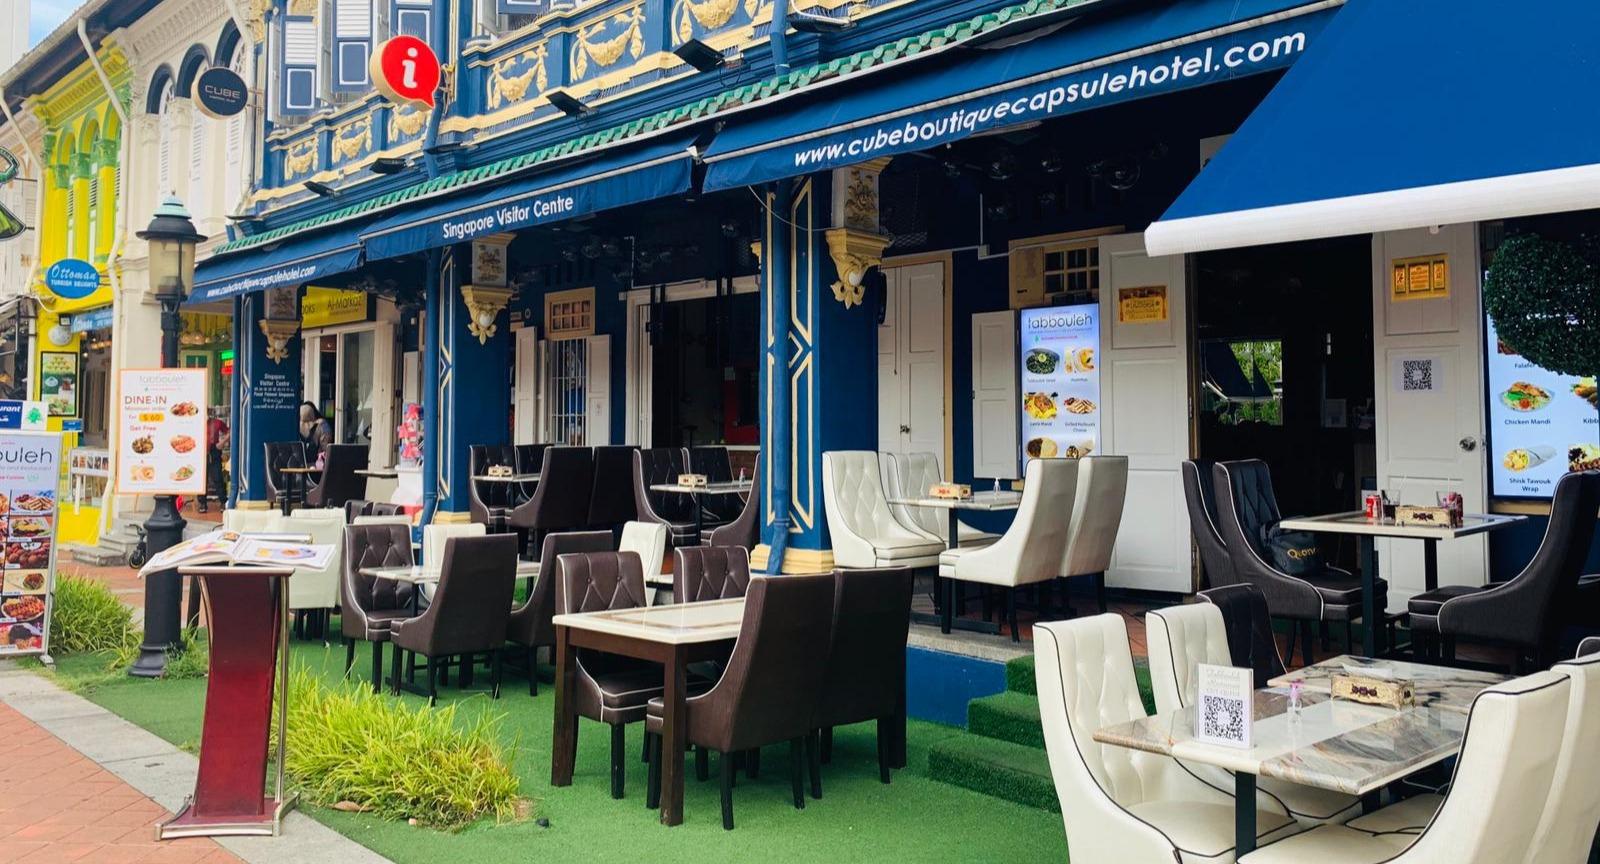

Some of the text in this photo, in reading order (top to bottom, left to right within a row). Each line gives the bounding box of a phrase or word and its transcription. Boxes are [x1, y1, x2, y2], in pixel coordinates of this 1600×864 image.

[205, 85, 240, 99] CUBE
[794, 31, 1306, 168] www.cubeboutiquecapsulehotel.com
[443, 195, 574, 239] Singapore Visitor Centre
[51, 264, 97, 280] Ottoman
[1028, 313, 1093, 329] tabbouleh
[124, 396, 167, 405] DINE-IN
